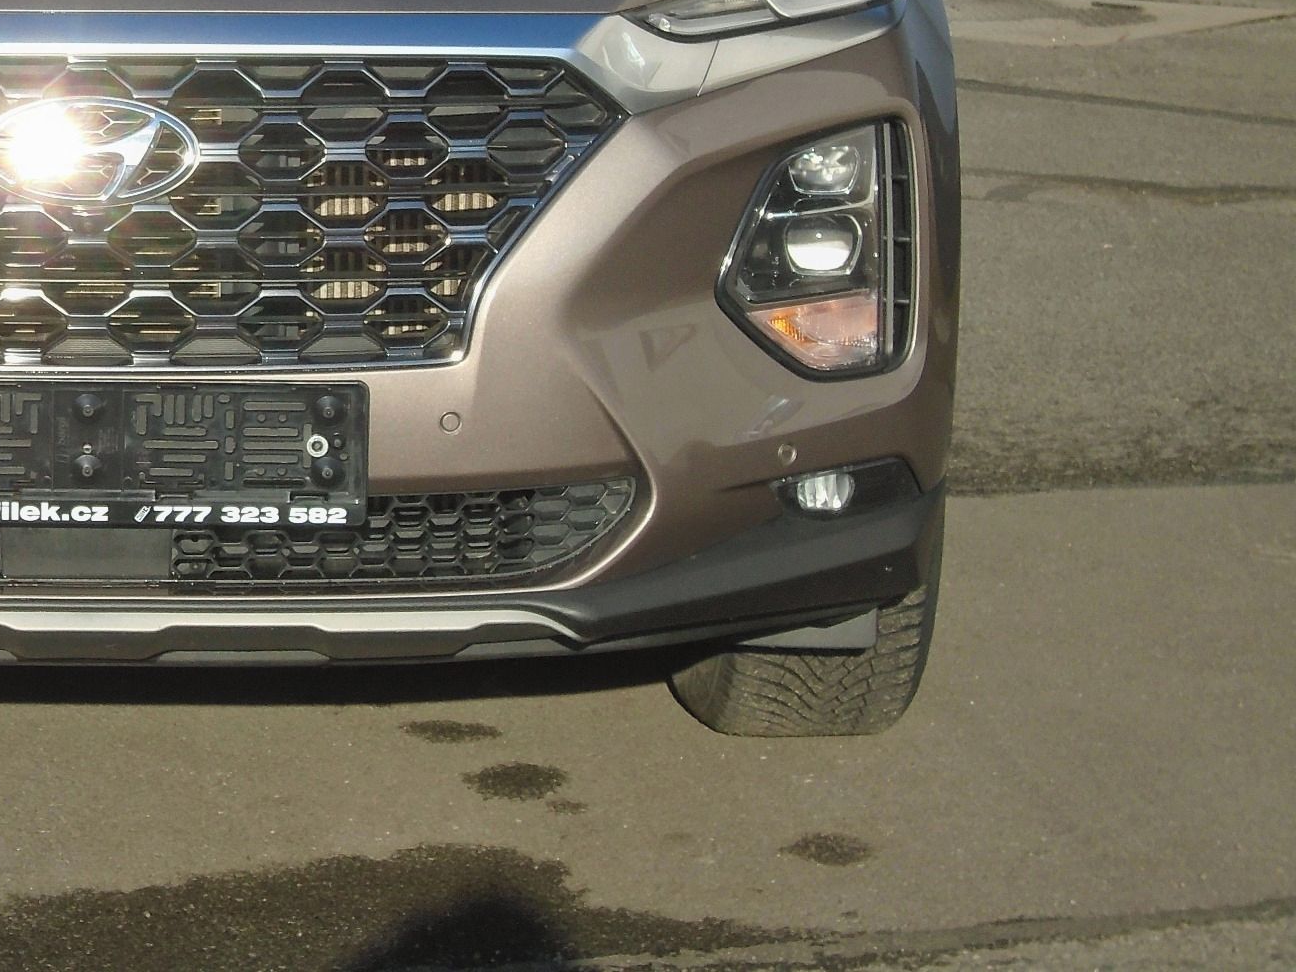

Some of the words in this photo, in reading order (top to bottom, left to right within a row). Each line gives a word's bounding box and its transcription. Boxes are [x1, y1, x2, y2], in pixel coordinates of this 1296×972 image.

[153, 506, 212, 523] 777
[220, 506, 280, 523] 323
[288, 507, 347, 524] 582
